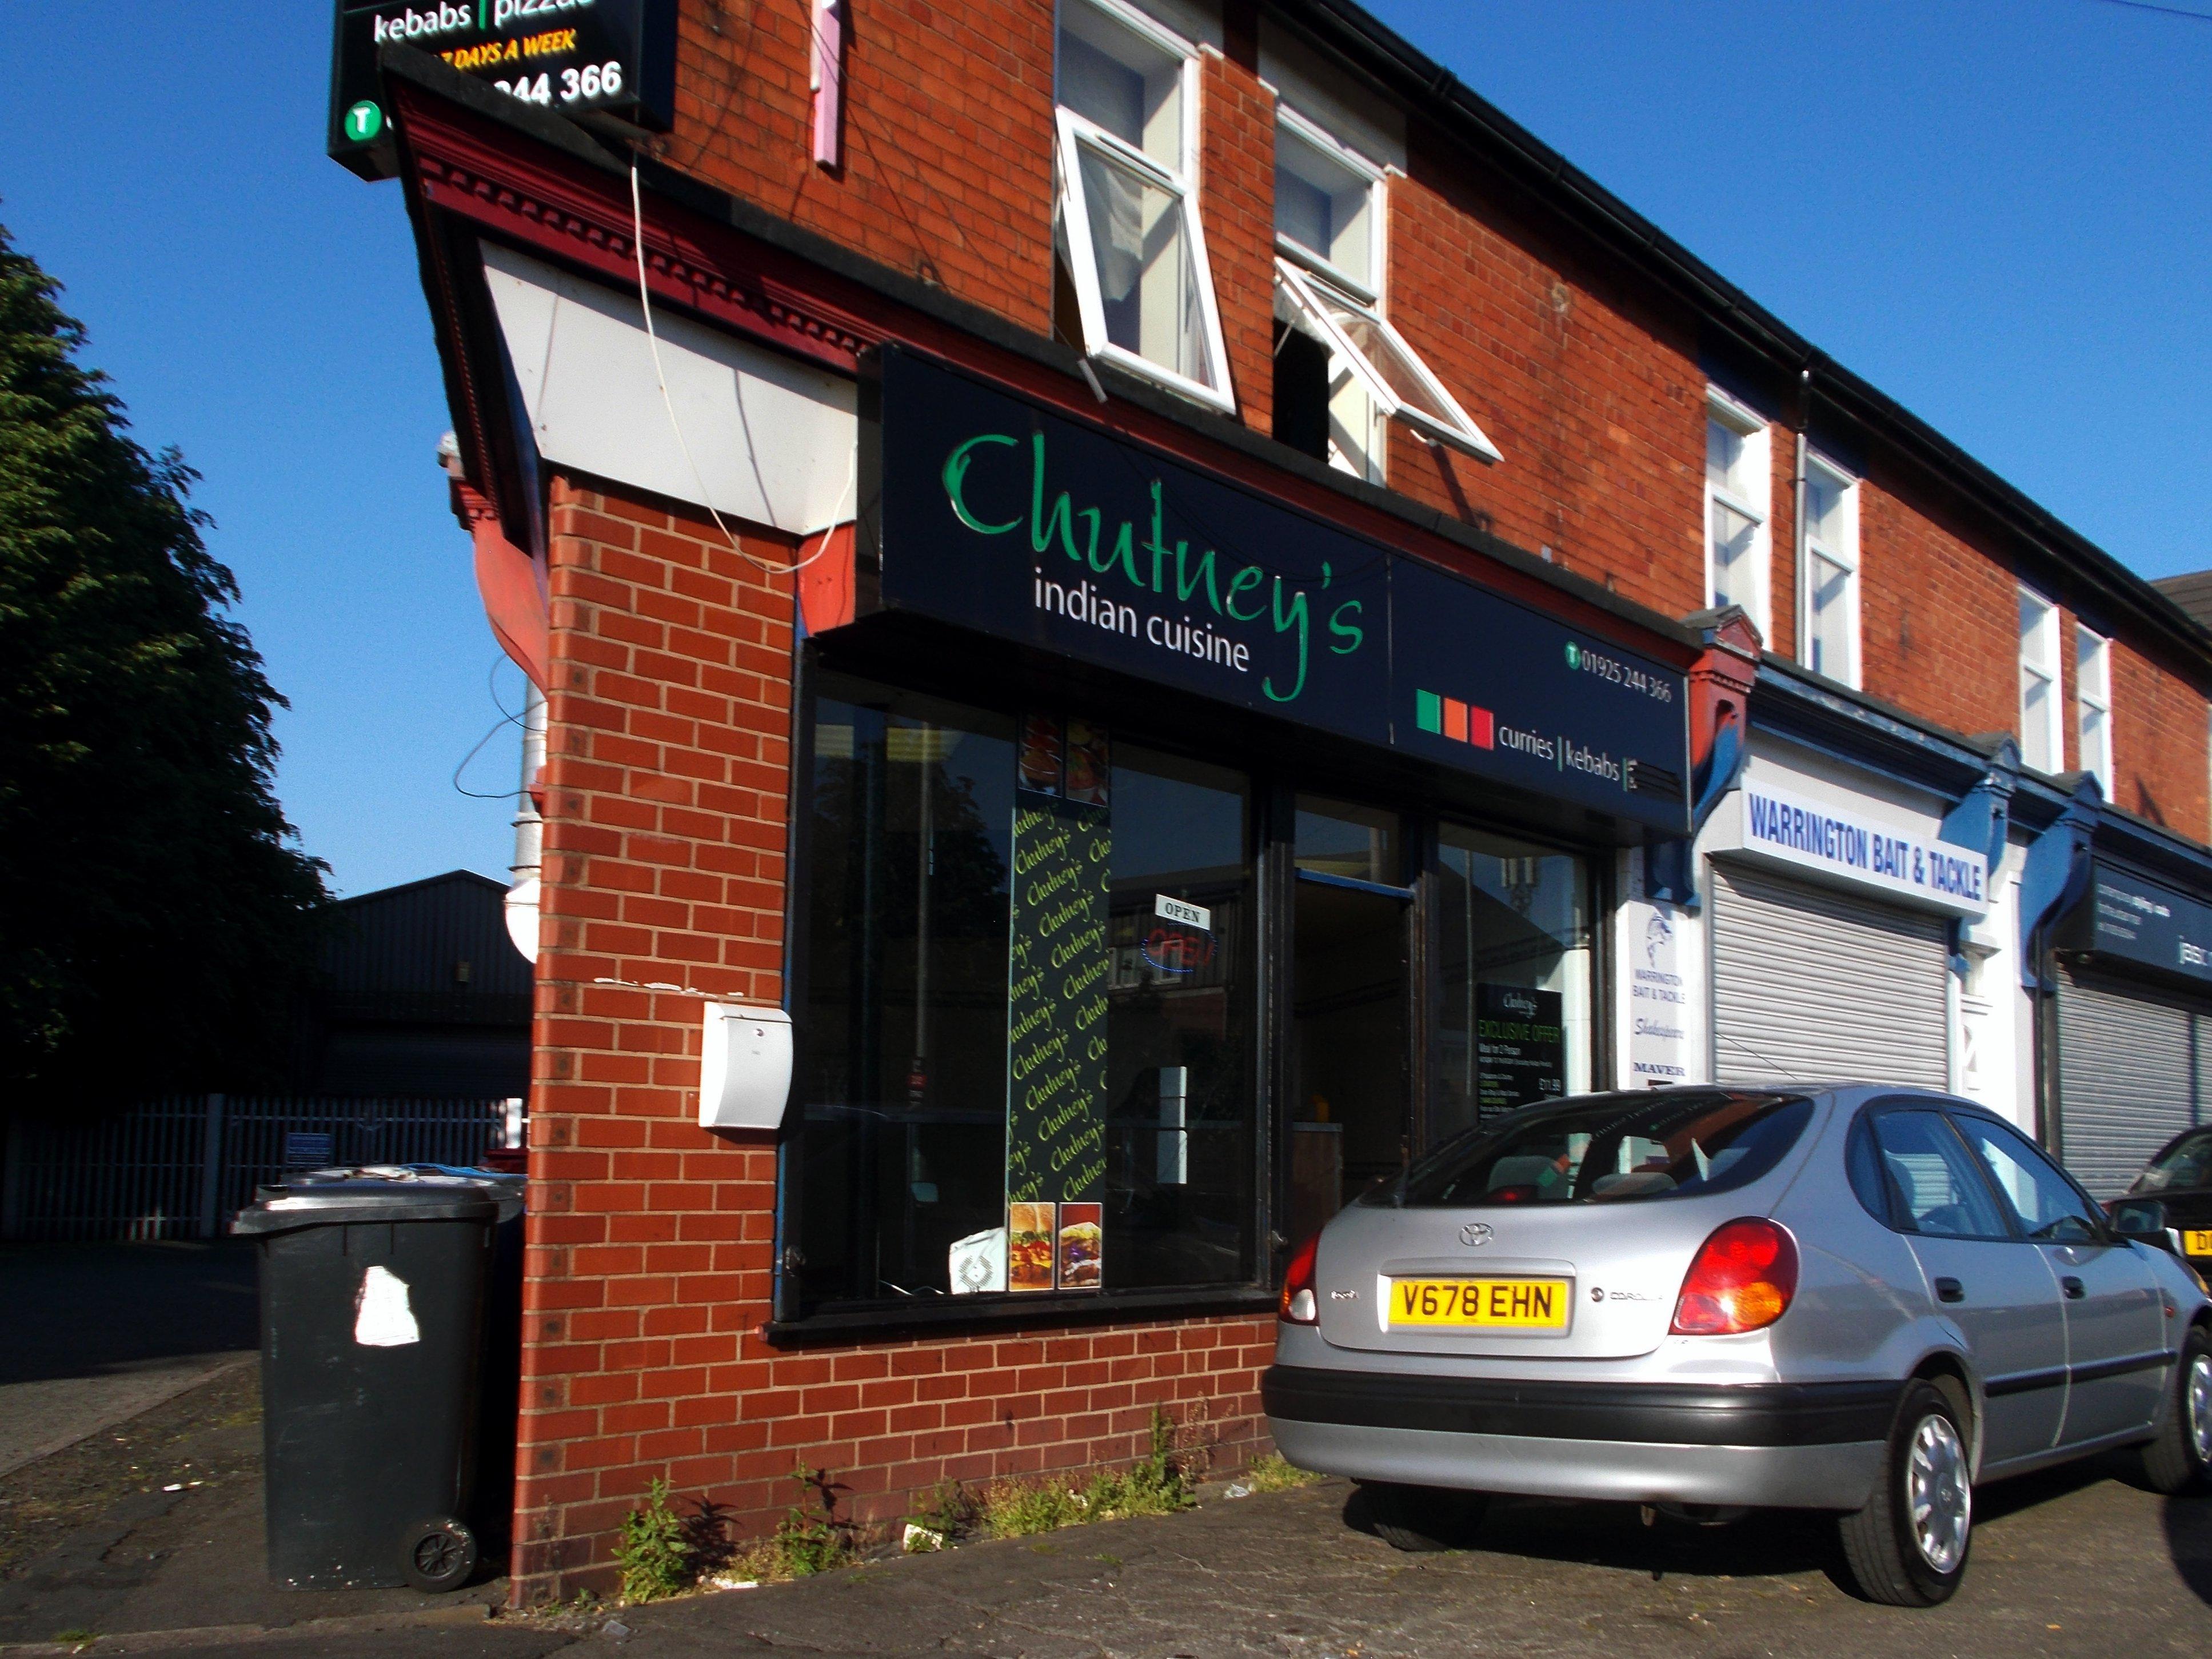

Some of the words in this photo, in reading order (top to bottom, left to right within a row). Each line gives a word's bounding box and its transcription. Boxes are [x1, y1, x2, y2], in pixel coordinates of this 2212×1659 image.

[374, 1, 473, 44] kebabs
[454, 42, 502, 69] DAYS
[504, 38, 518, 60] A
[522, 28, 576, 57] WEEK
[560, 61, 622, 100] 366
[943, 430, 1364, 702] Chutney's
[1035, 566, 1137, 637] indian
[1147, 614, 1250, 672] cuisine
[1581, 649, 1622, 683] 01925
[1623, 666, 1647, 694] 244
[1648, 676, 1672, 703] 366
[1499, 726, 1555, 761] curries
[1565, 739, 1620, 781] kebabs
[1748, 792, 1868, 869] WARRINGTON
[1871, 833, 1910, 880] BAIT
[1913, 846, 1926, 885] &
[1929, 850, 1982, 902] TACKLE
[1165, 902, 1200, 923] OPEN
[1633, 985, 1651, 999] BAIT
[1659, 989, 1686, 1004] TACKLE
[1635, 969, 1683, 986] WARRINGTON
[1478, 1020, 1531, 1041] EXCLUSIVE
[1532, 1025, 1560, 1044] OFFER
[1633, 1062, 1686, 1077] MAVER
[1403, 1285, 1480, 1317] V678
[1490, 1285, 1553, 1319] EHN
